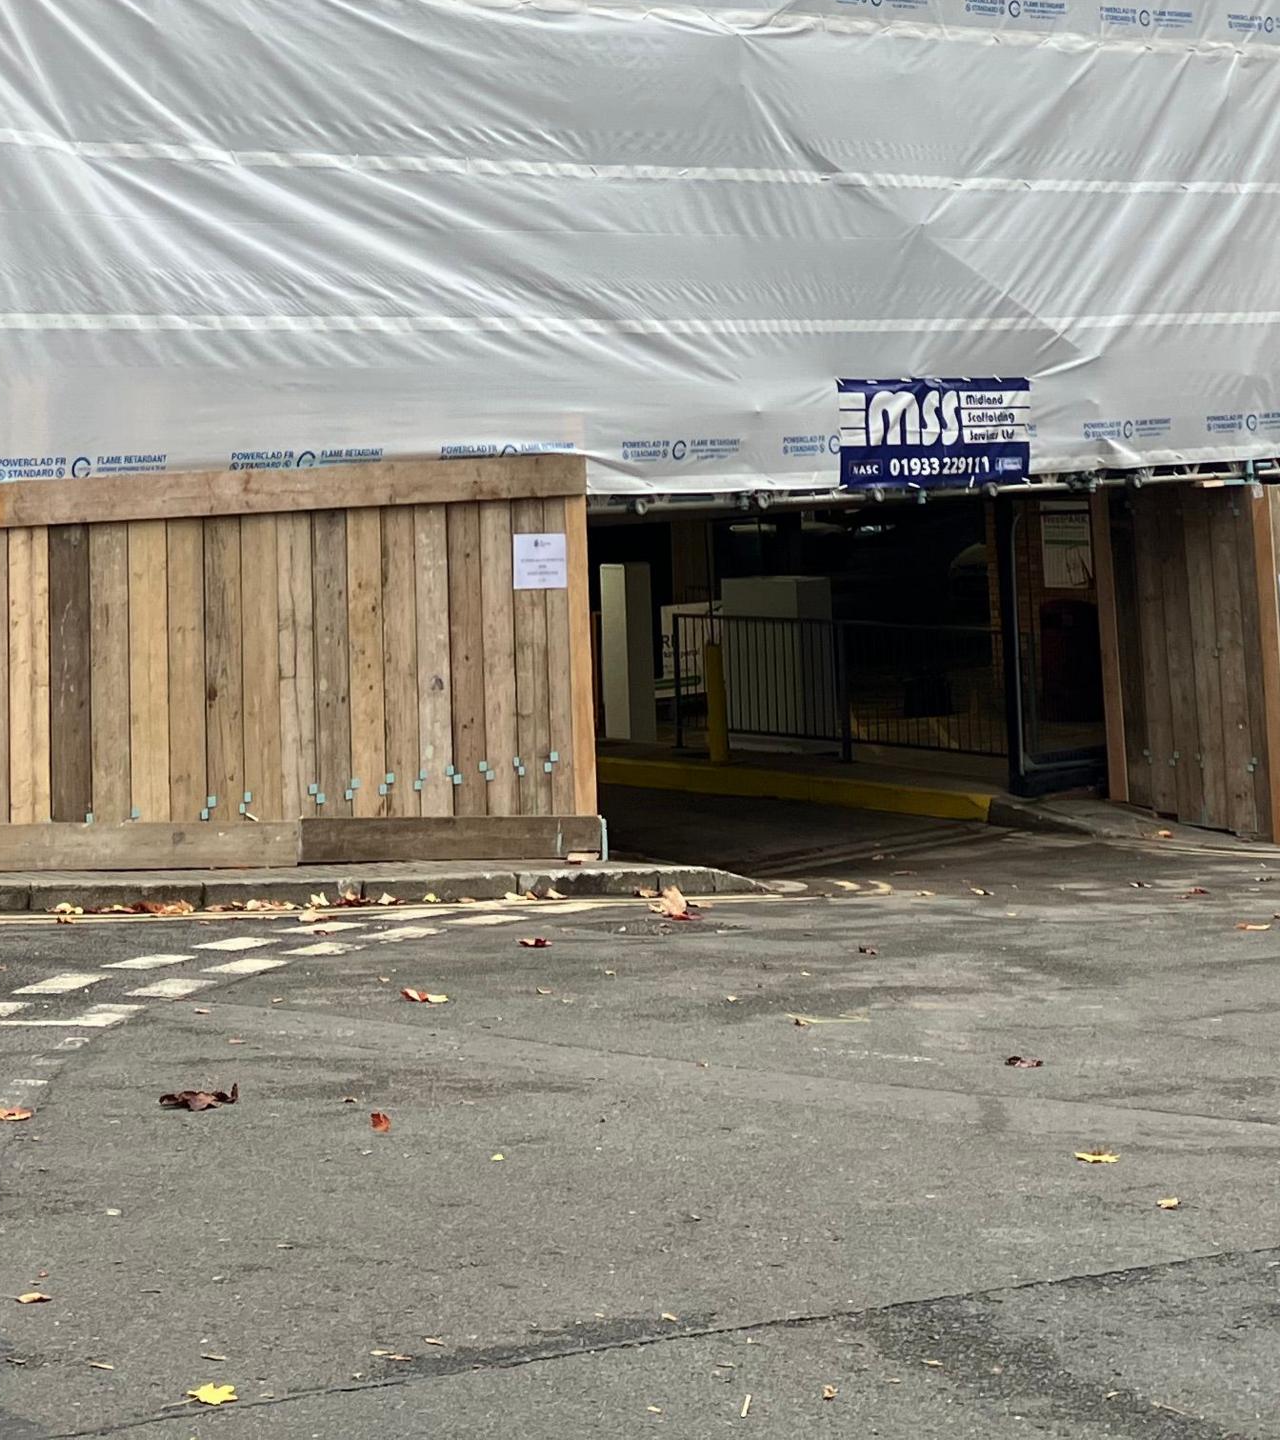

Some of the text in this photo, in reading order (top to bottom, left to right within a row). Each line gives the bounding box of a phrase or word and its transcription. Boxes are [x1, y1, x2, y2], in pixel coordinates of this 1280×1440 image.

[972, 4, 999, 12] STANDARD
[965, 392, 1003, 405] Midland
[967, 412, 1015, 424] Scaffolding
[969, 430, 1015, 441] Services Ltd
[622, 441, 659, 449] POWERCLAD
[321, 448, 383, 458] FLAME RETARDANT
[441, 446, 487, 454] POWERCLAD
[97, 454, 167, 465] FLAME RETARDANT
[231, 451, 283, 460] POWERCLAD
[240, 461, 281, 470] STANDARD
[852, 464, 879, 475] NASC
[889, 457, 940, 476] 01933
[942, 456, 989, 475] 229111
[8, 469, 53, 478] STANDARD
